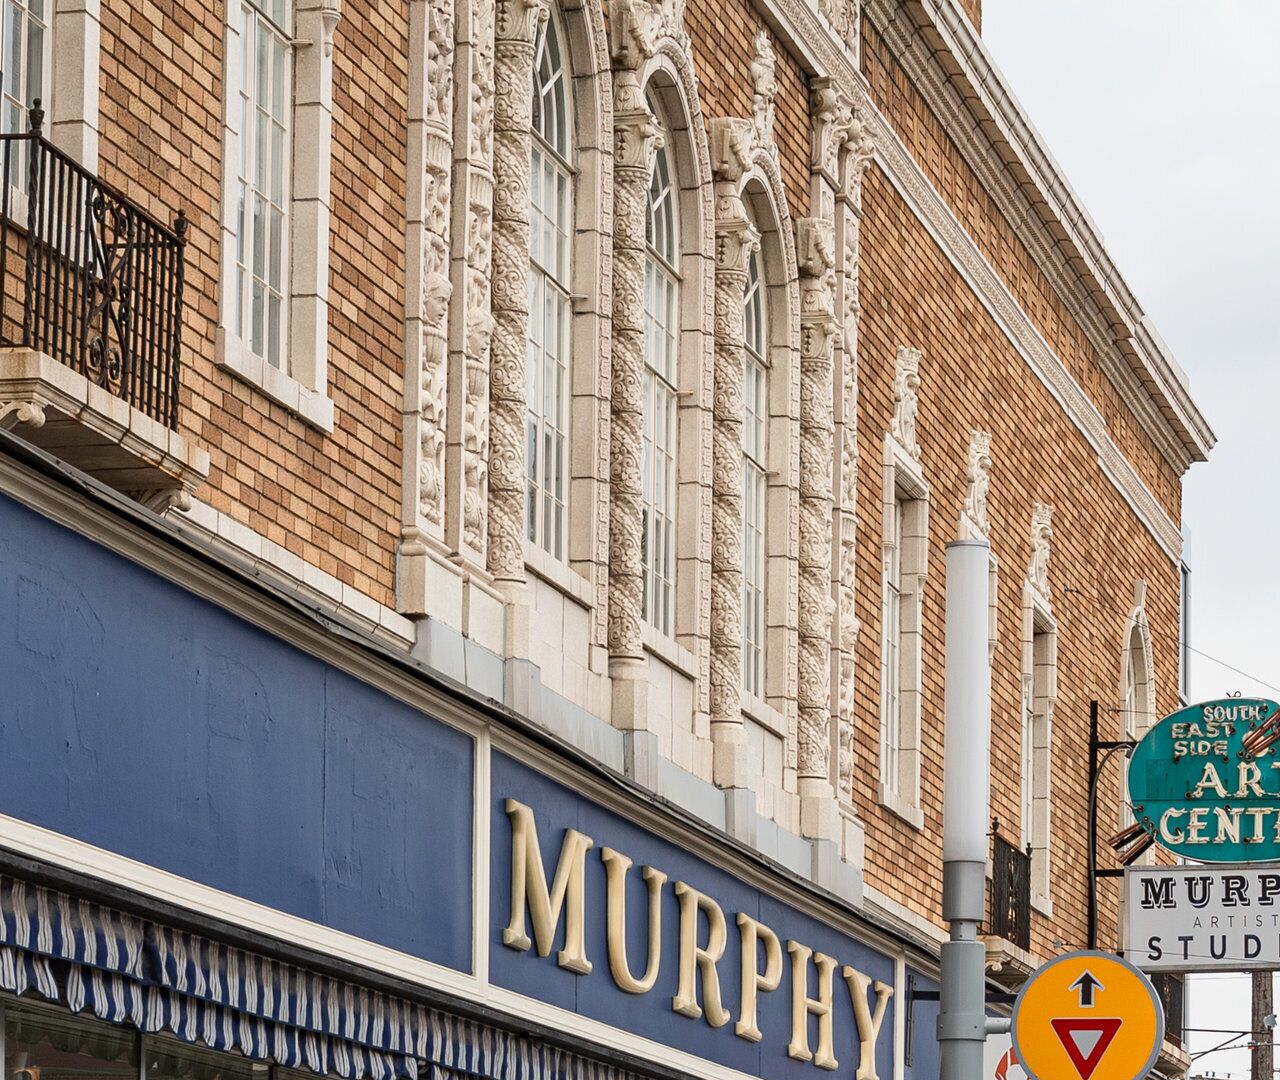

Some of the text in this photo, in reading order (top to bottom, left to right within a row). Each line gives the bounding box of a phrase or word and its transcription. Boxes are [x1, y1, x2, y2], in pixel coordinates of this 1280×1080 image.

[1203, 705, 1262, 723] SOUTH
[1171, 721, 1234, 739] EAST
[1173, 740, 1228, 757] SIDE
